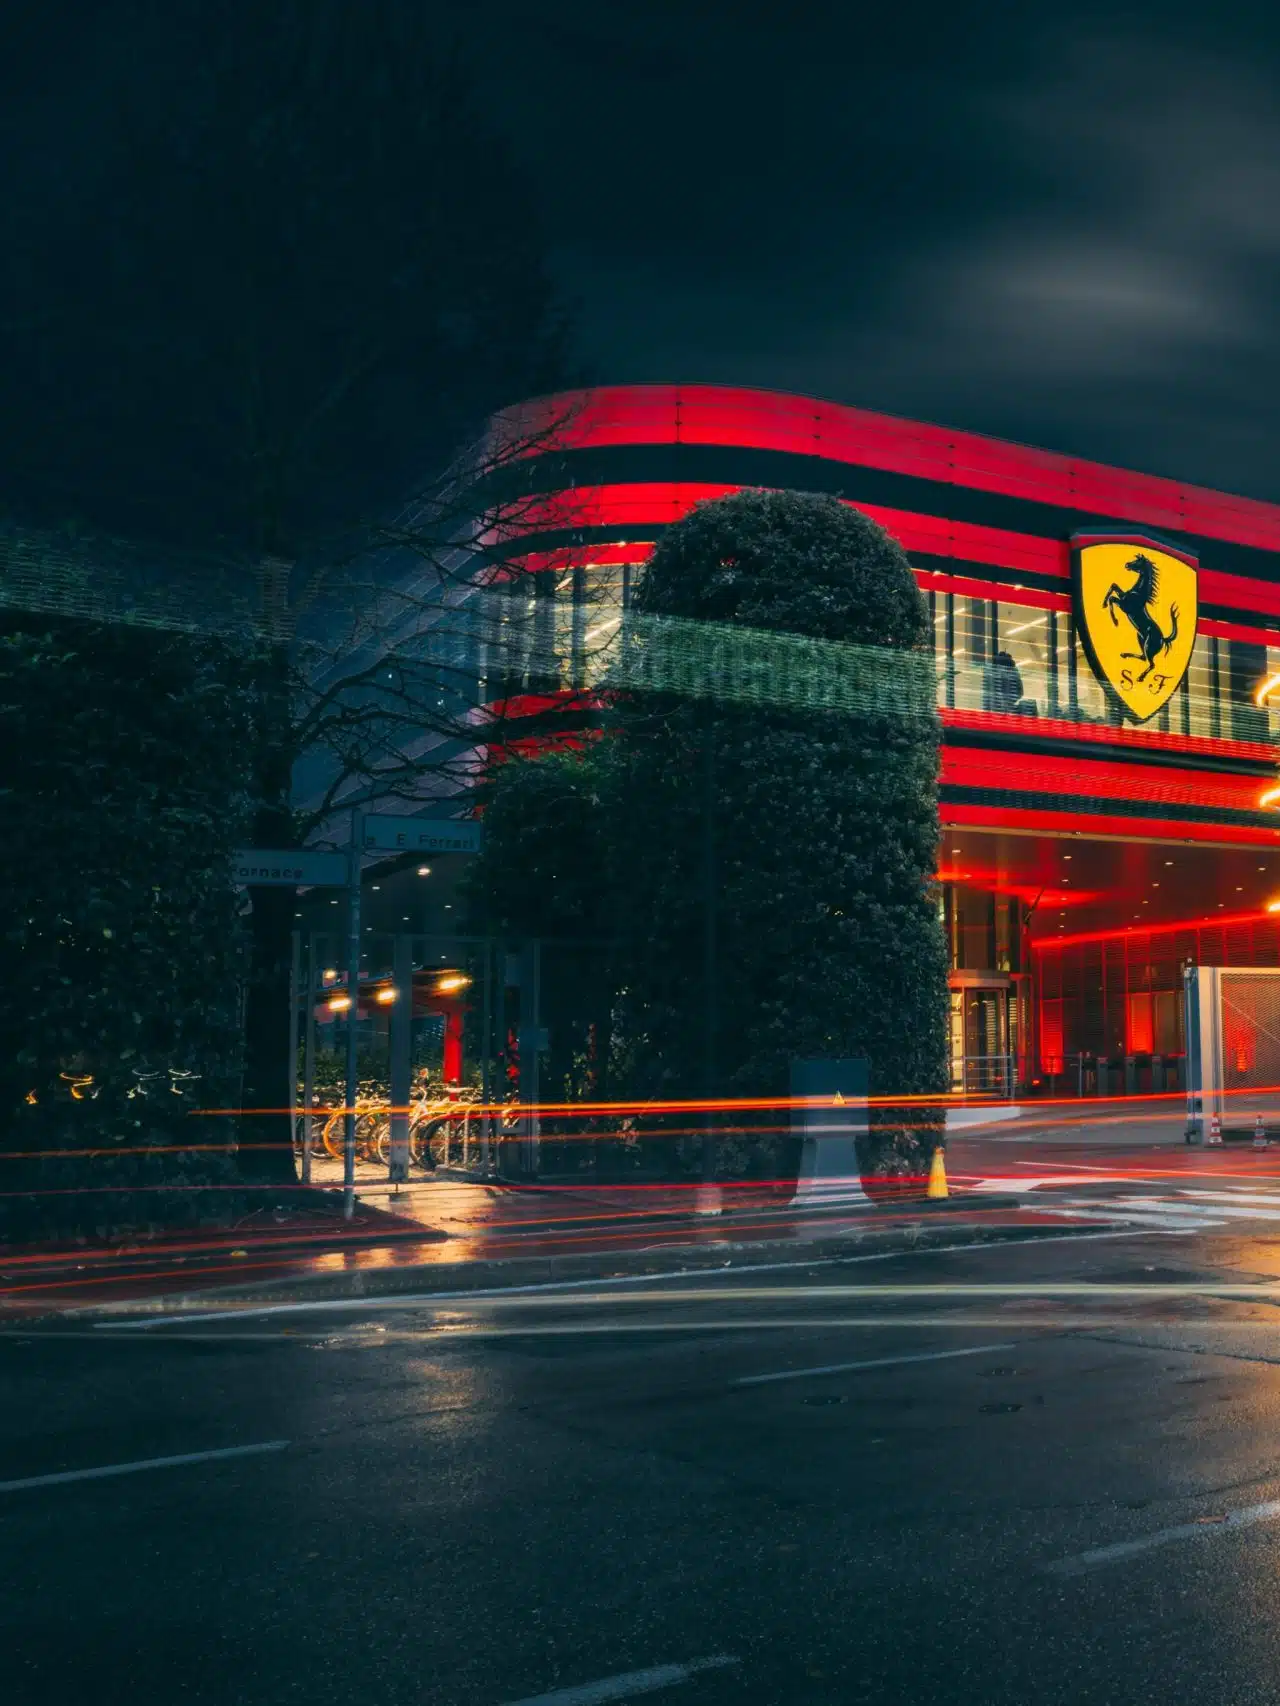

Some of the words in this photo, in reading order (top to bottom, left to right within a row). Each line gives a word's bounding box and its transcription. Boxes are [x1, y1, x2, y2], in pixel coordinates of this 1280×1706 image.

[1120, 669, 1134, 691] S
[1148, 674, 1174, 695] F
[419, 834, 474, 849] Ferrari
